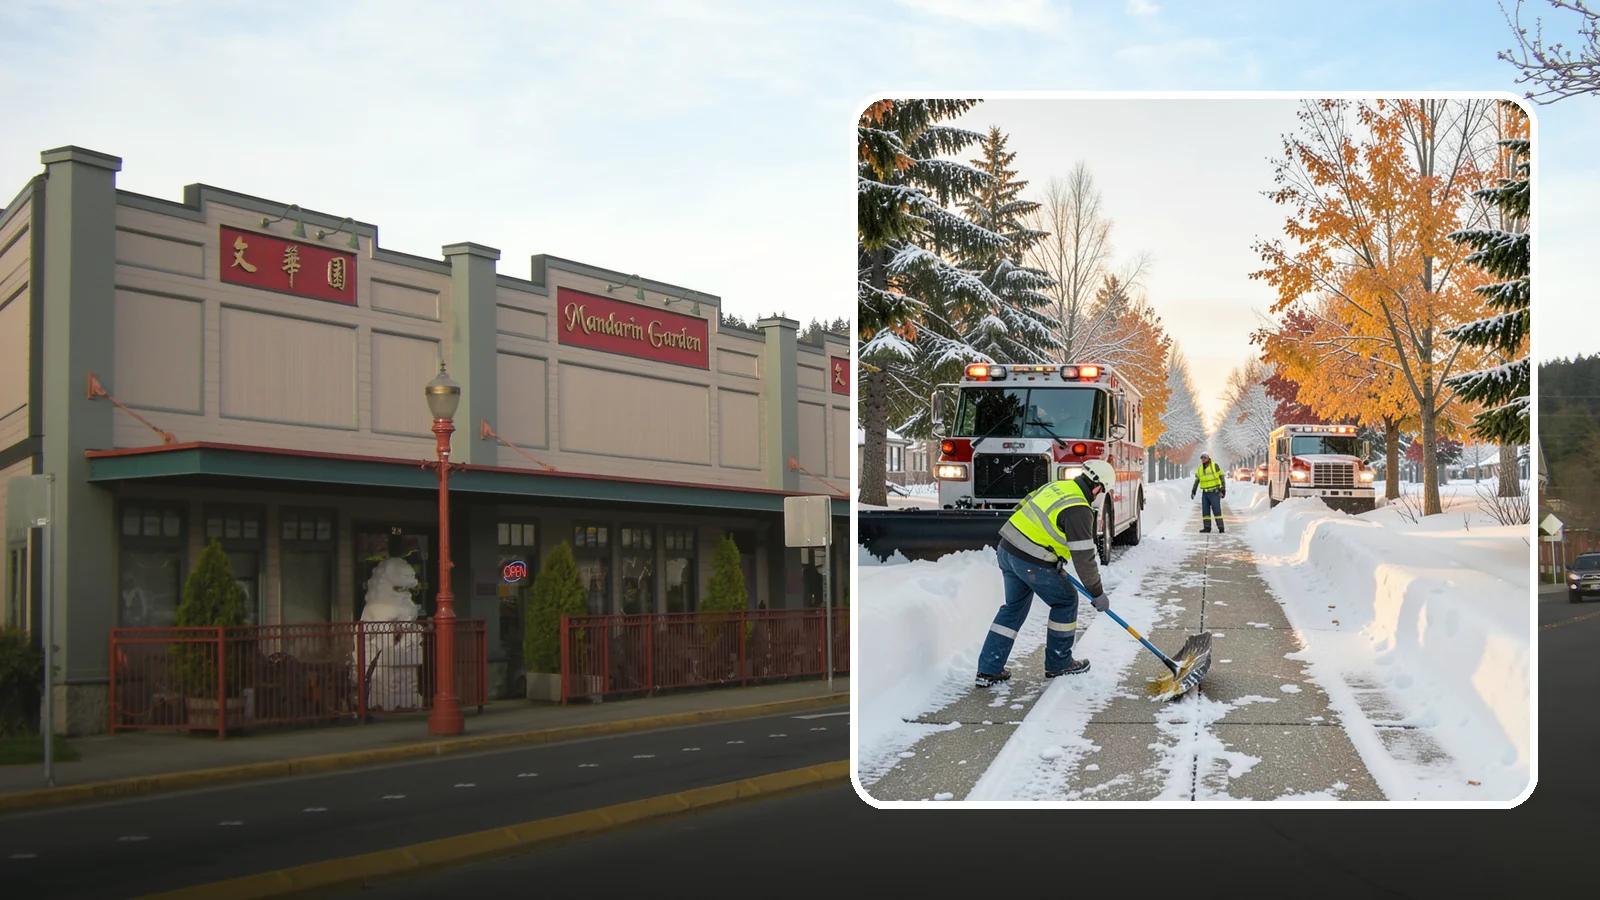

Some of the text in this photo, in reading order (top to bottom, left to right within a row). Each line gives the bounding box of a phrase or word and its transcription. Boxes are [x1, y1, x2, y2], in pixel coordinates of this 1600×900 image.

[564, 302, 701, 352] Mandarin Garden
[834, 363, 846, 386] 文
[503, 565, 527, 578] OPEN
